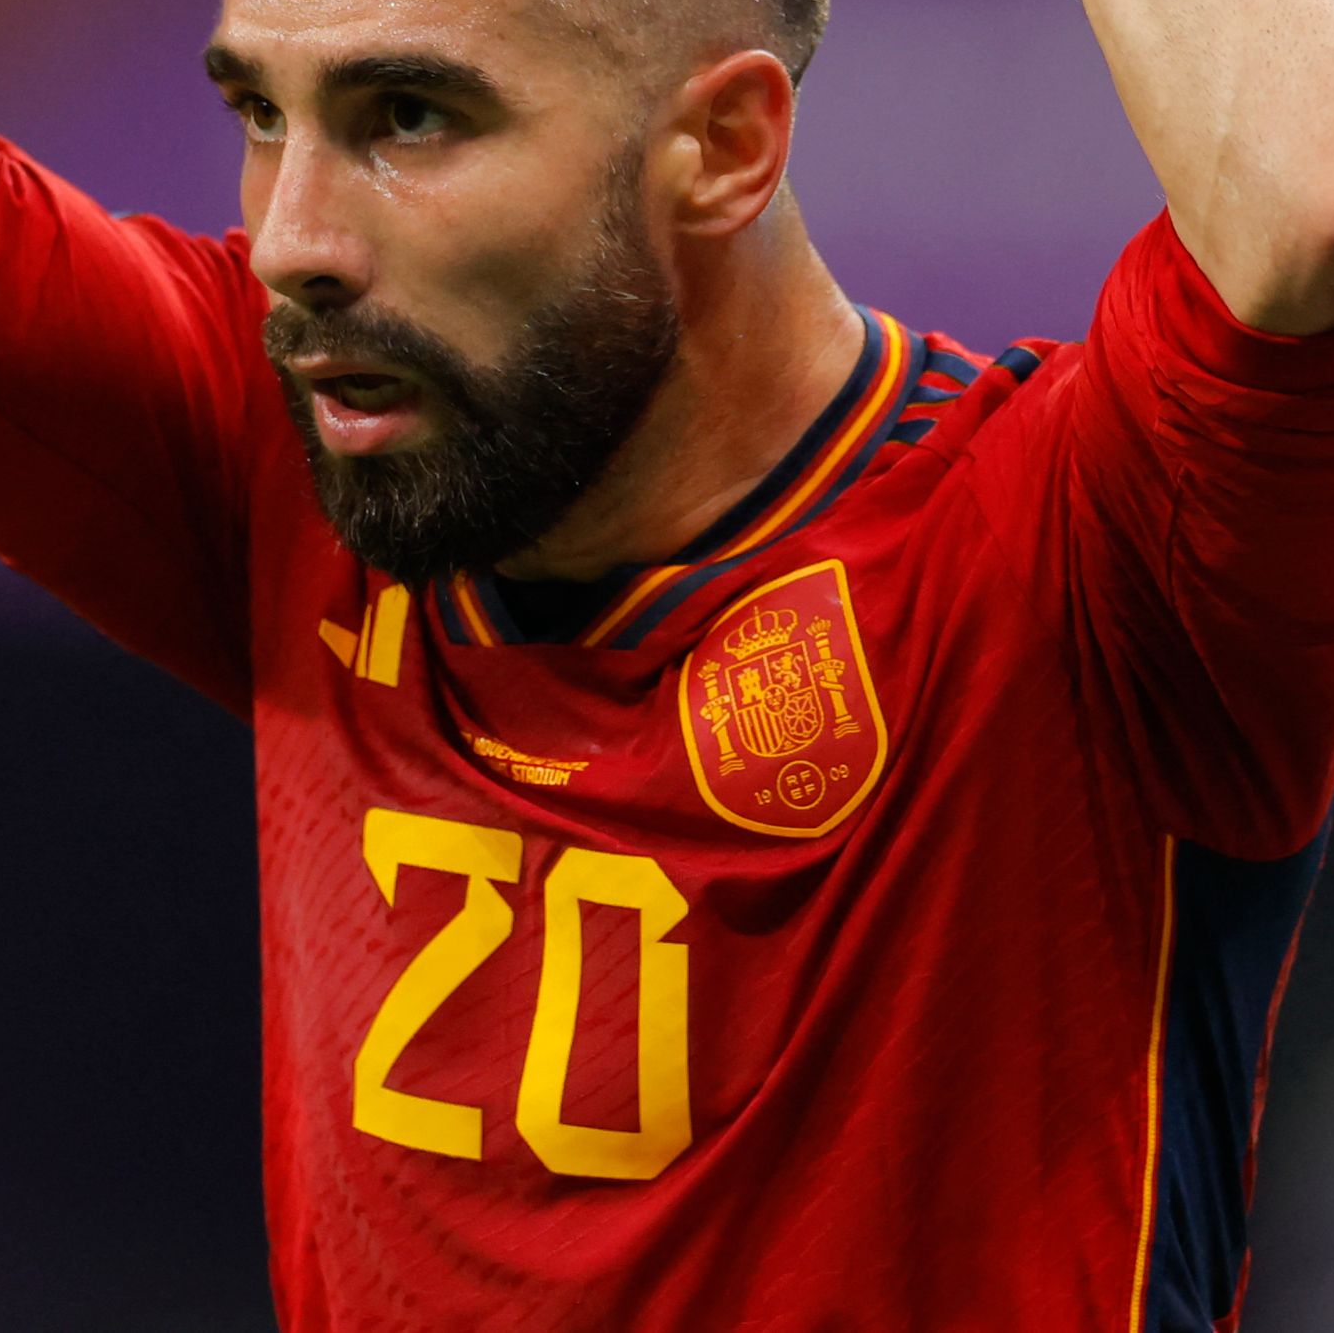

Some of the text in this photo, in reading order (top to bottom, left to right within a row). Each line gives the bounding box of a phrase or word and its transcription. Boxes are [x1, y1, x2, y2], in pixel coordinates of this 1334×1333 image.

[511, 763, 571, 786] STADIUM
[830, 764, 849, 782] 09
[754, 789, 772, 805] 19
[353, 807, 692, 1180] 20
